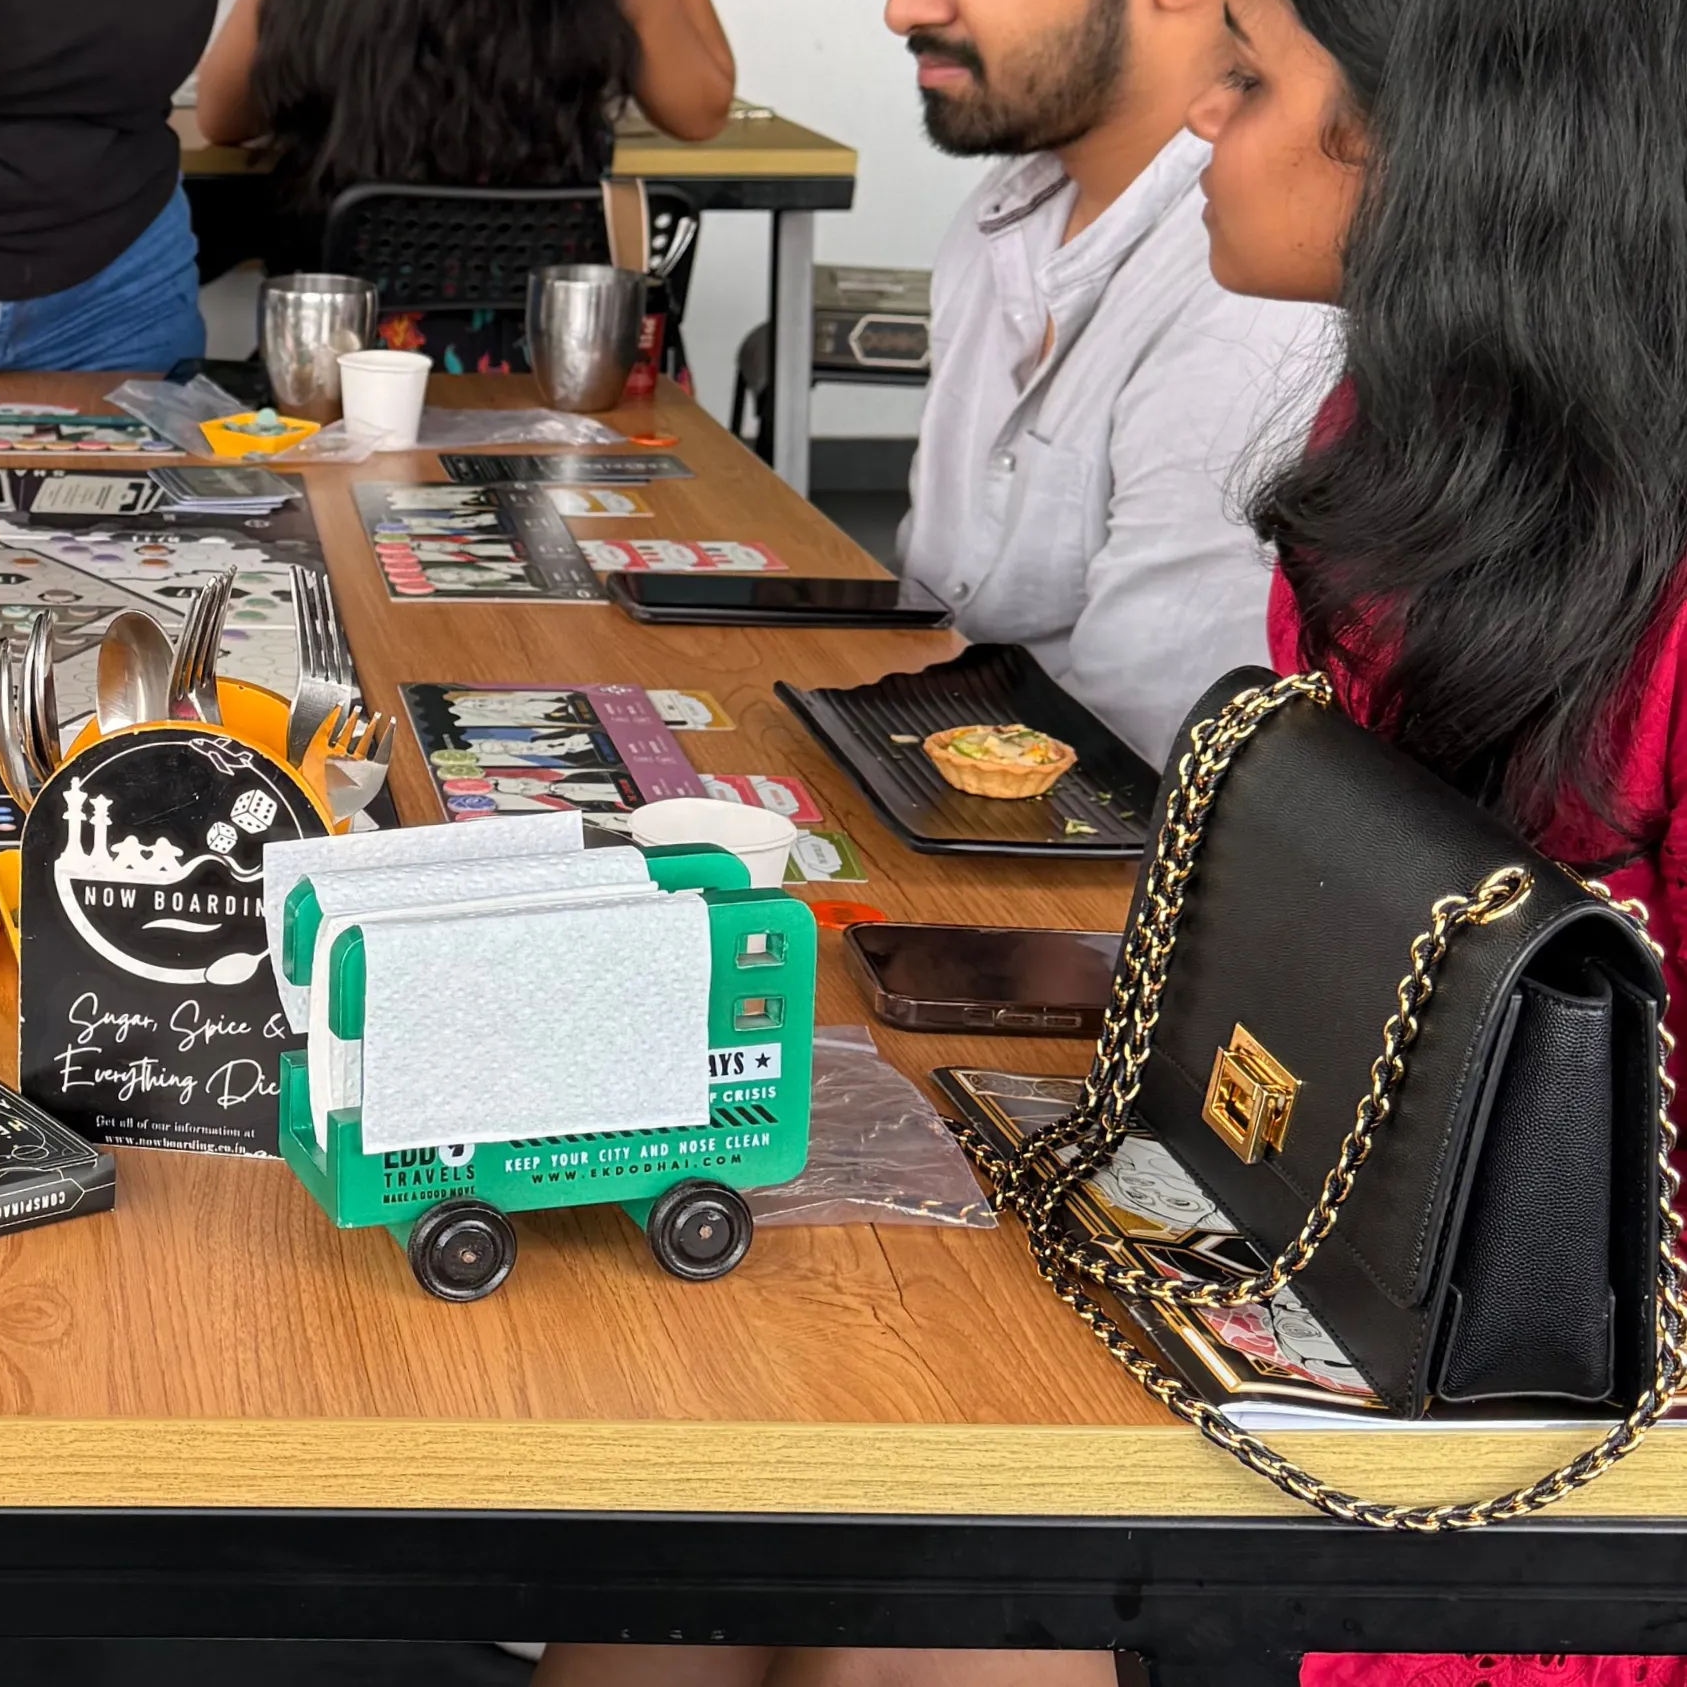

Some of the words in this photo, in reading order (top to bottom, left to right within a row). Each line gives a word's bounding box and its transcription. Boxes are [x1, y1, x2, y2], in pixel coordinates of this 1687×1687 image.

[85, 886, 136, 908] NOW
[154, 892, 265, 917] BOARDIN
[68, 992, 158, 1044] Sugar,
[169, 999, 252, 1052] Spice
[263, 1013, 286, 1039] &
[53, 1043, 198, 1105] Everything
[205, 1058, 281, 1109] Dic
[708, 1052, 744, 1077] AYS
[709, 1092, 717, 1104] F
[722, 1086, 777, 1103] CRISIS
[96, 1114, 116, 1128] Get
[119, 1117, 133, 1129] all
[136, 1119, 149, 1130] of
[151, 1121, 171, 1132] our
[174, 1121, 240, 1137] information
[243, 1128, 255, 1139] at
[505, 1157, 540, 1173] KEEP
[551, 1151, 588, 1167] YOUR
[599, 1147, 631, 1162] CITY
[640, 1143, 669, 1158] AND
[679, 1138, 715, 1154] NOSE
[725, 1132, 771, 1150] CLEAN
[383, 1164, 475, 1188] TRAVELS
[531, 1153, 742, 1184] WWW.EKDODHAI.COM
[383, 1192, 408, 1204] MAKE
[411, 1191, 418, 1201] A
[450, 1186, 475, 1197] MOVE
